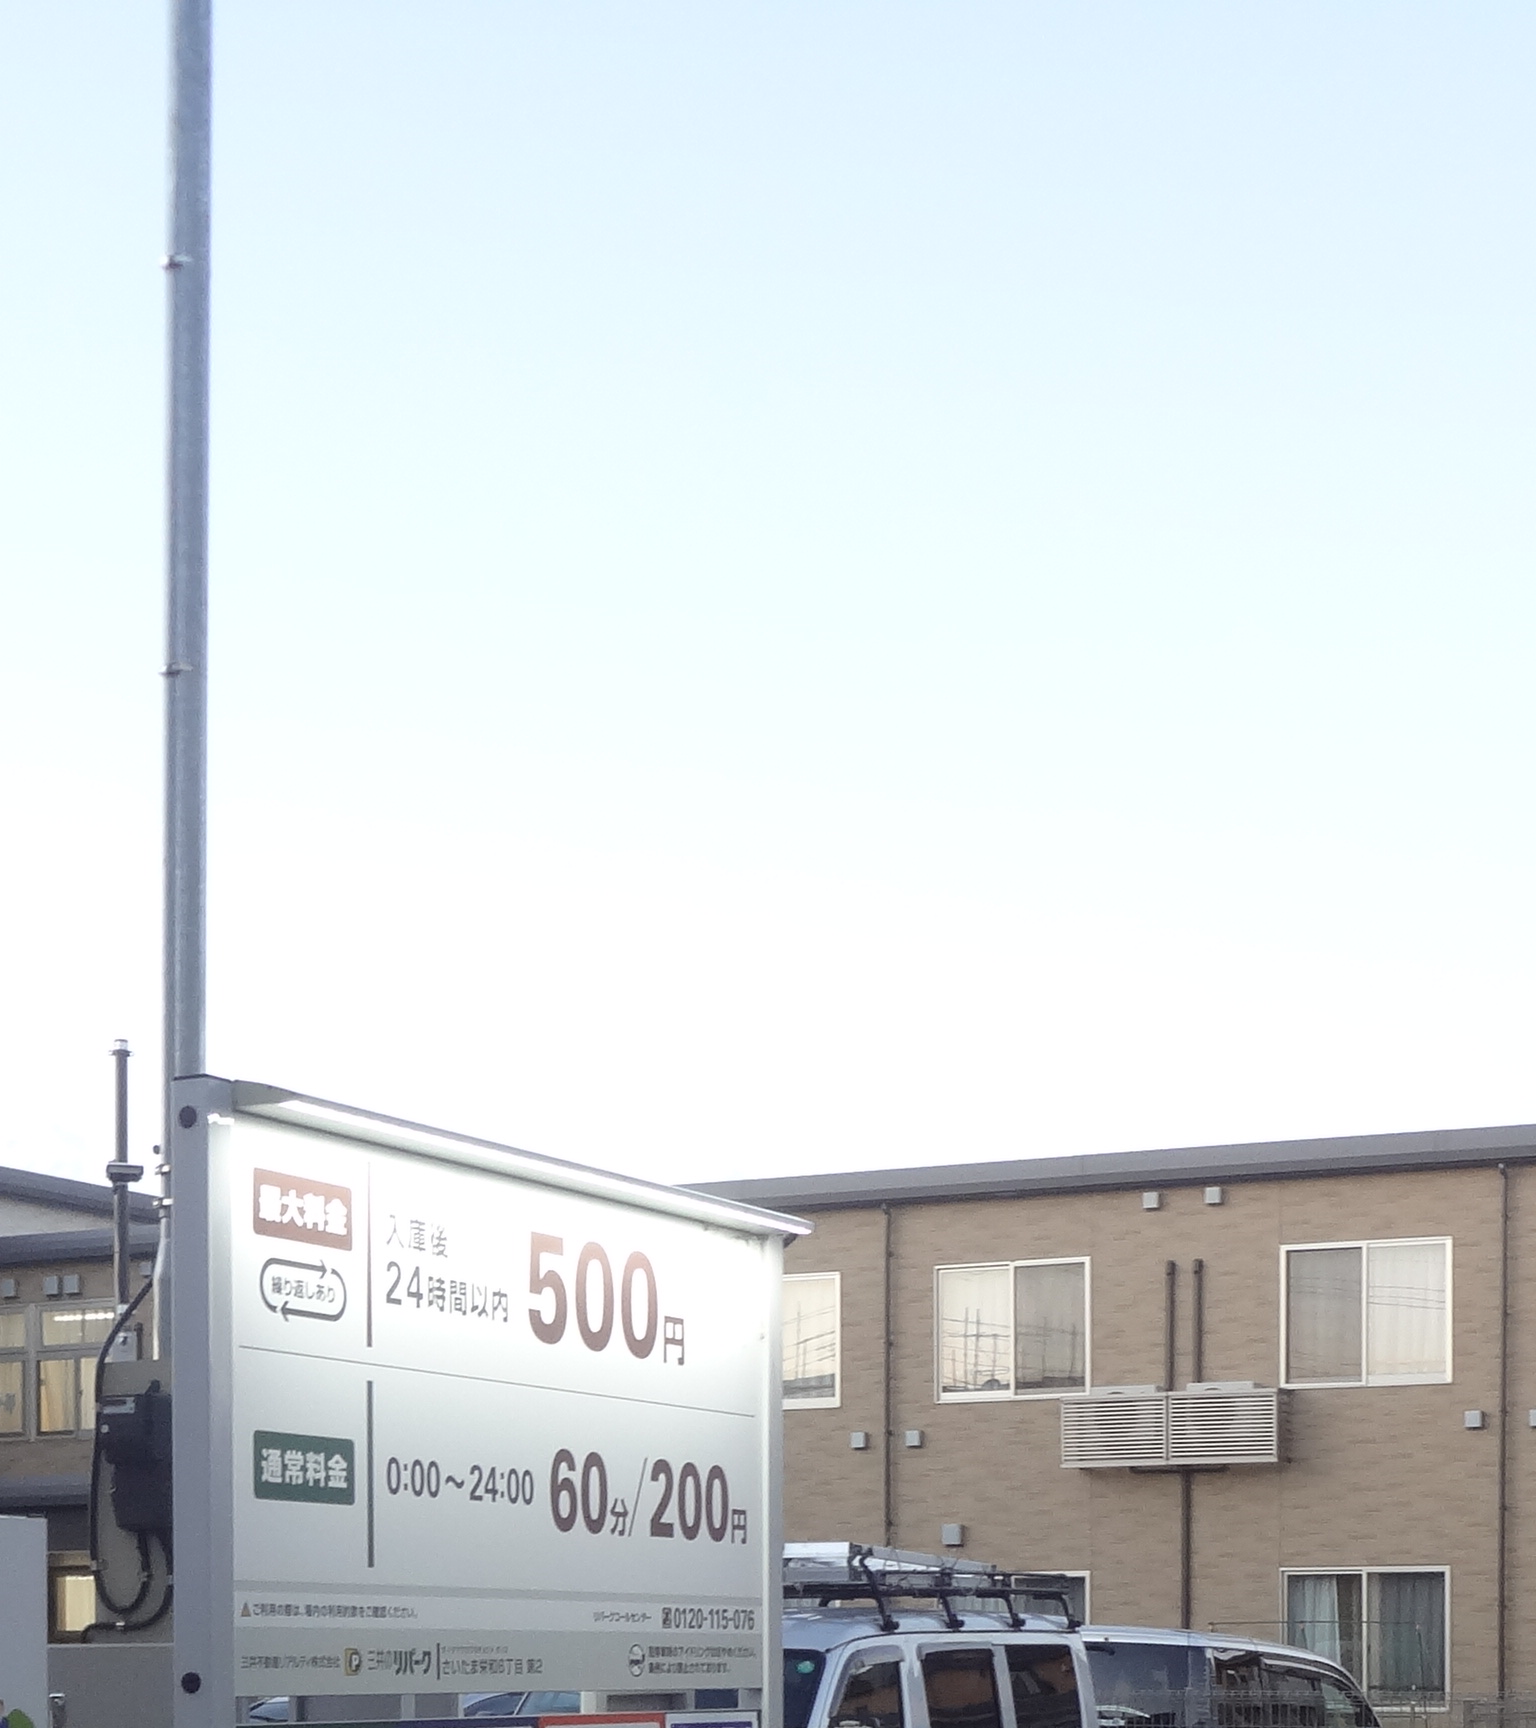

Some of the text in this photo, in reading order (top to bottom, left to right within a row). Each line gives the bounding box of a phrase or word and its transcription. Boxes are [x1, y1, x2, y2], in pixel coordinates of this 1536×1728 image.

[259, 1184, 347, 1236] 最大料金
[386, 1214, 448, 1258] 入庫後
[271, 1275, 336, 1303] 繰り返しあり
[386, 1260, 509, 1322] 24時間以内
[528, 1231, 685, 1366] 500円
[261, 1448, 350, 1489] 通常料金
[673, 1608, 755, 1631] 0120-115-076
